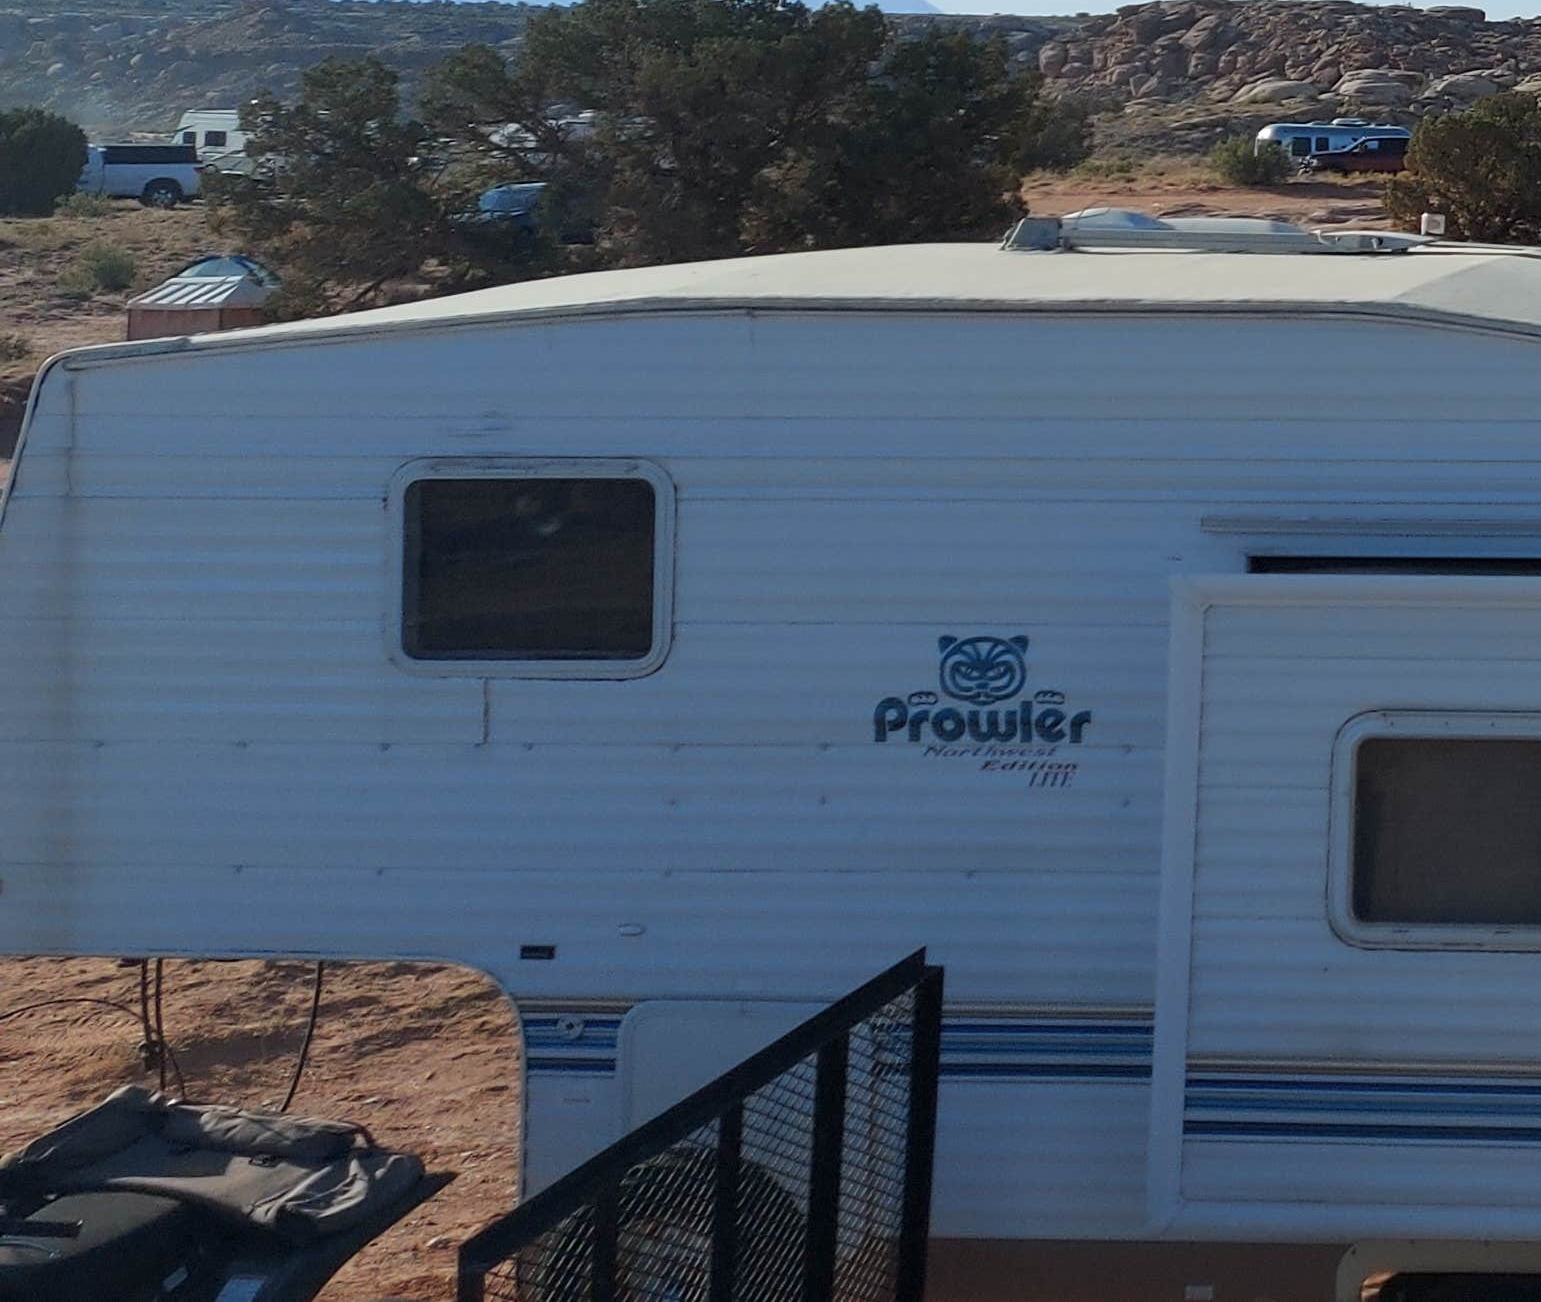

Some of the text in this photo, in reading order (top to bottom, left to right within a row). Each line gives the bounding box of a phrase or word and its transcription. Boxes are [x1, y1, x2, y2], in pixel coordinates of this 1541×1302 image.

[873, 696, 1092, 744] Prowler
[922, 745, 1057, 758] Northwest
[979, 759, 1079, 772] Edition
